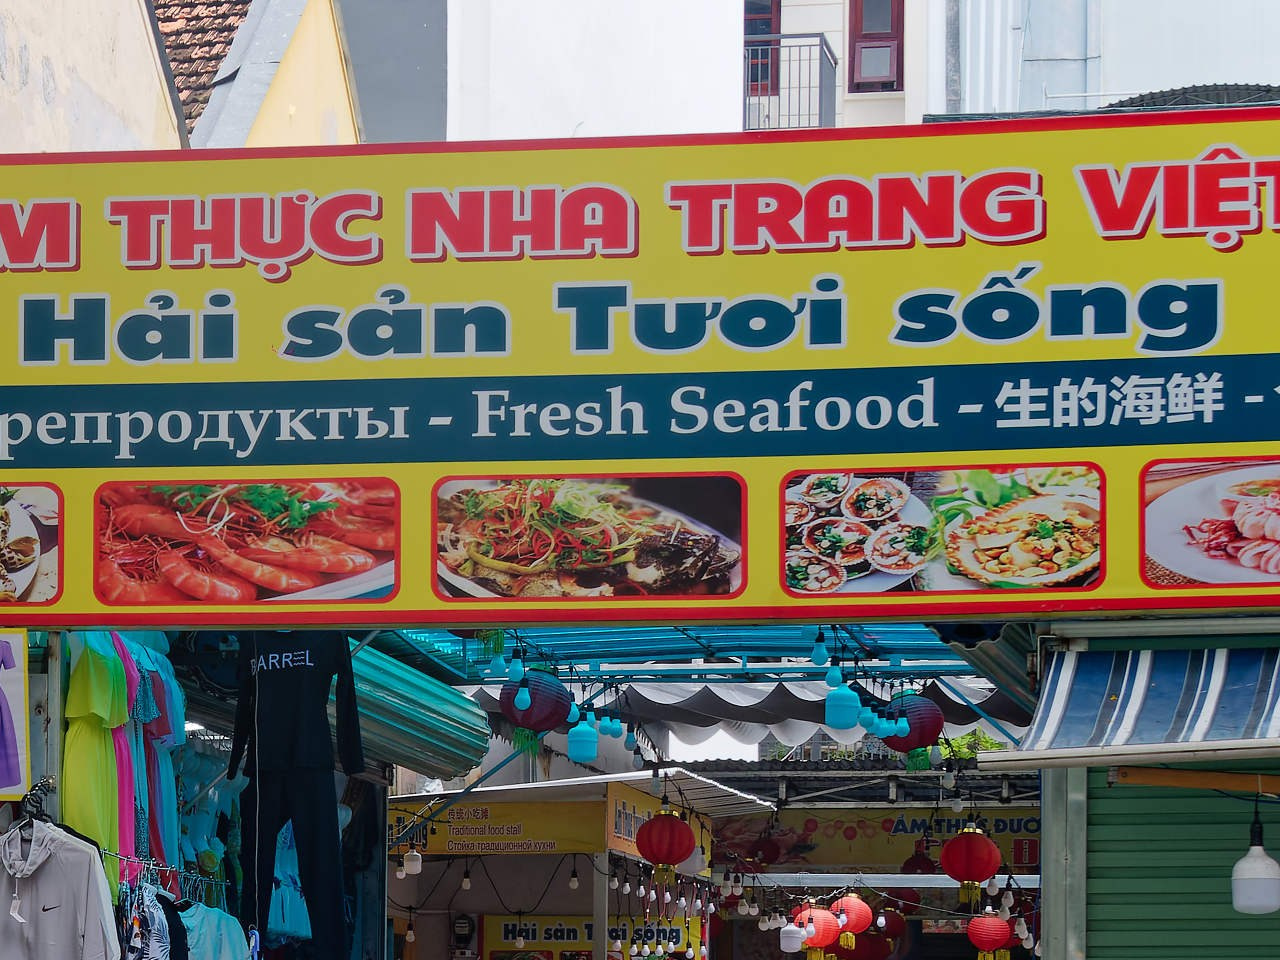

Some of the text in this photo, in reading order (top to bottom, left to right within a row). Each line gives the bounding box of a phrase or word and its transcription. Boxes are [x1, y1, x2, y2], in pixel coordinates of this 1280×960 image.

[106, 190, 382, 282] THỰC
[407, 183, 639, 261] NHA
[668, 168, 1046, 255] TRANG
[19, 262, 1223, 366] Hải sản Tươi sống
[472, 386, 646, 438] Fresh
[669, 378, 940, 434] Seafood
[995, 371, 1225, 431] 生的海鲜
[448, 824, 522, 836] Traditional food stall
[448, 840, 556, 853] Стойка традиционной кухни
[504, 921, 537, 941] Hải
[544, 921, 578, 941] sản
